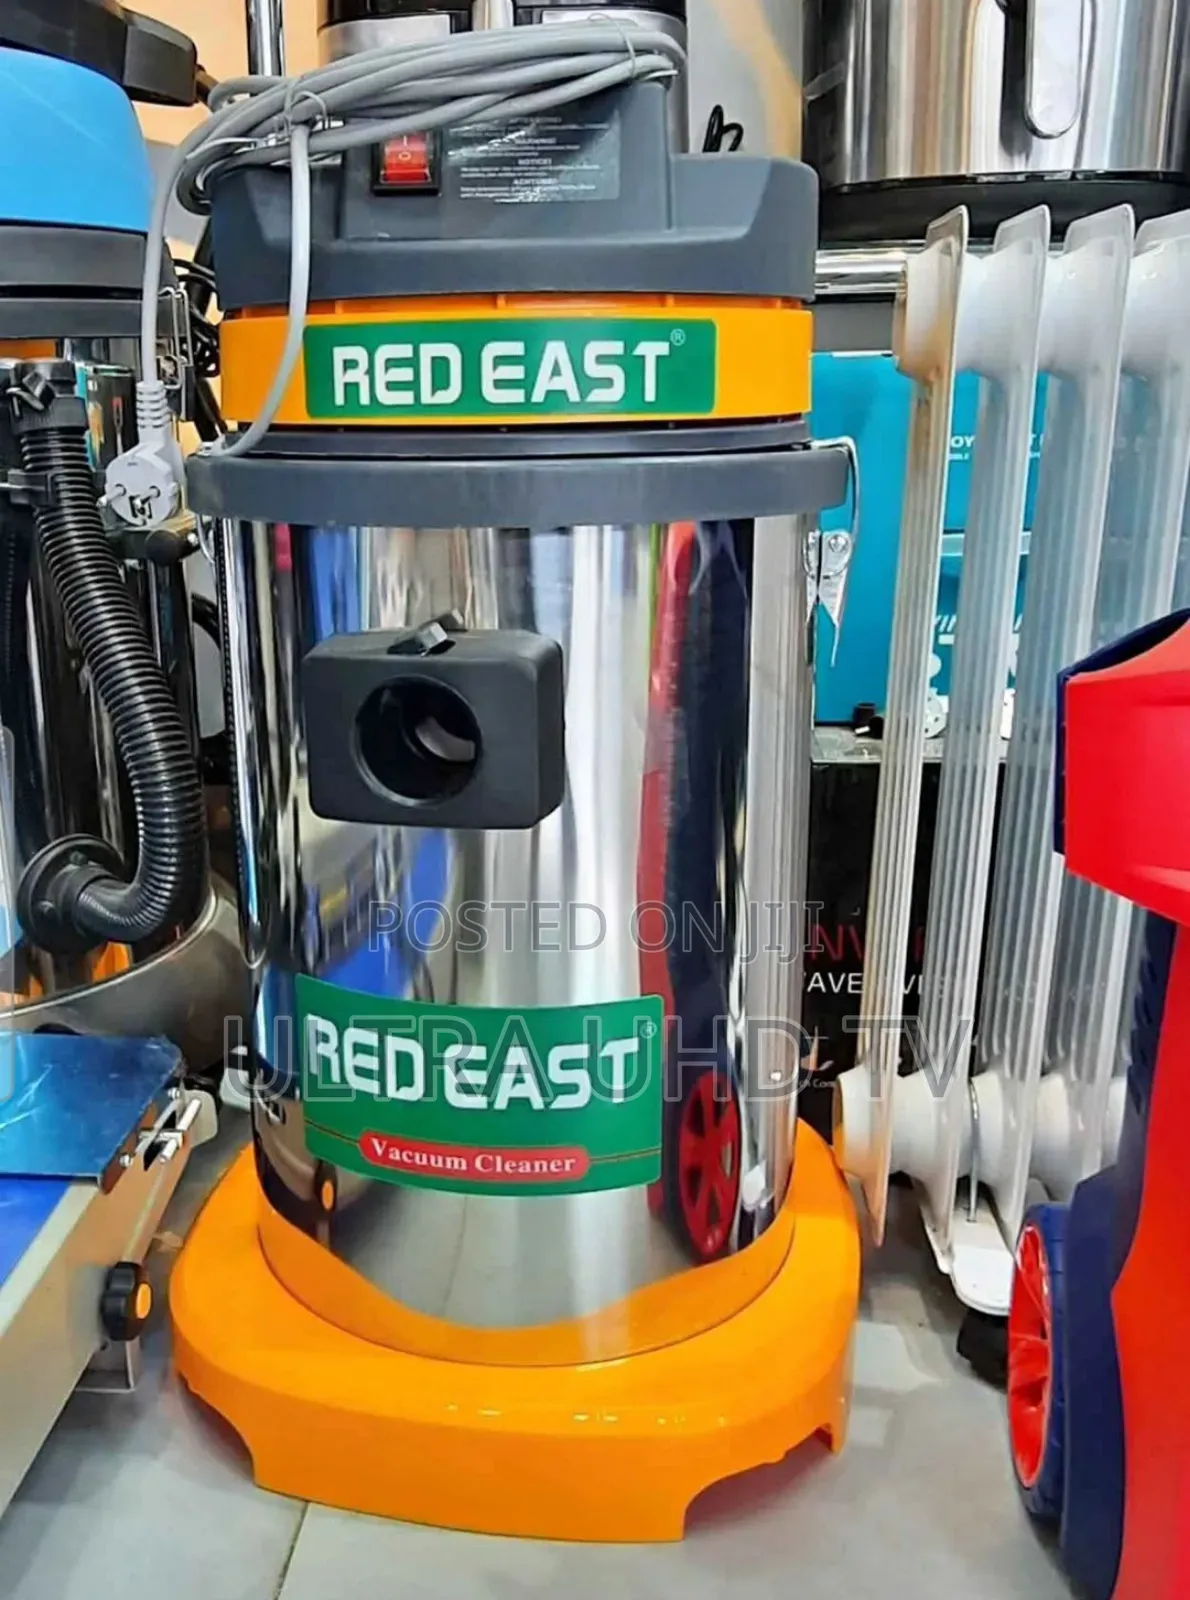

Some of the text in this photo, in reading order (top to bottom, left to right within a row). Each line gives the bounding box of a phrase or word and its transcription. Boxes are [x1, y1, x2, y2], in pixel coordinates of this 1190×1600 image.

[333, 340, 670, 406] RED EAST
[803, 972, 864, 994] AVE
[306, 1013, 640, 1111] RED EAST
[370, 1137, 577, 1174] Vacuum Cleaner
